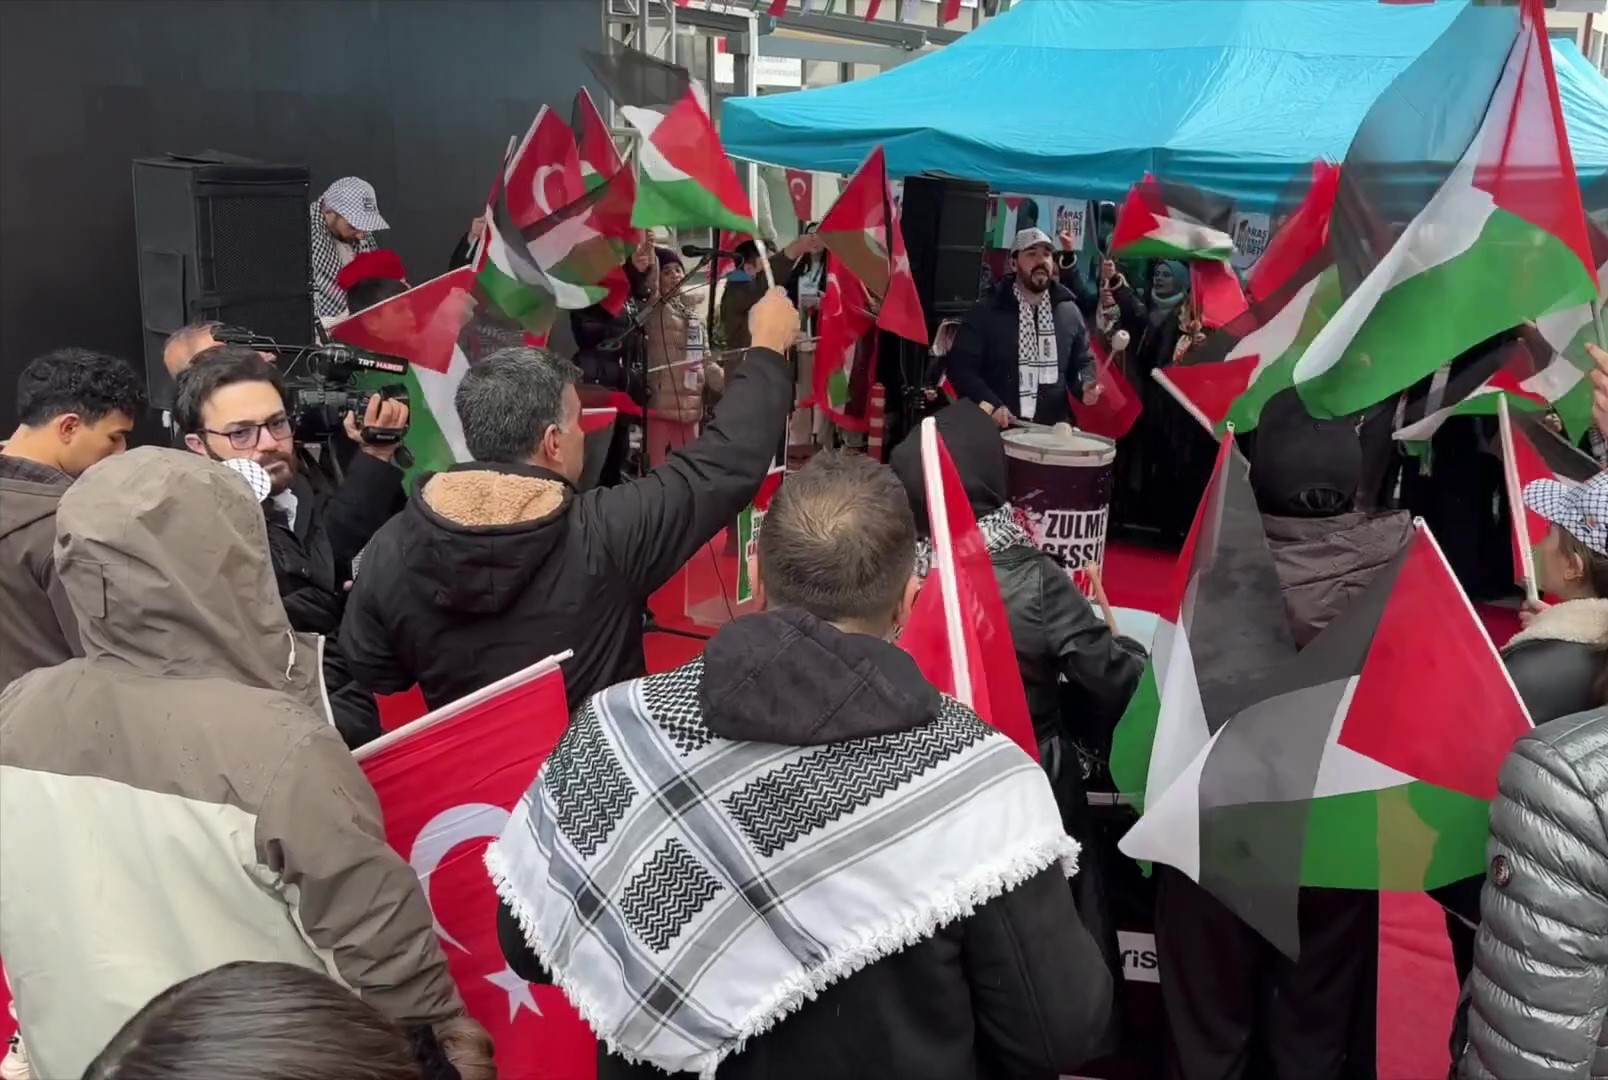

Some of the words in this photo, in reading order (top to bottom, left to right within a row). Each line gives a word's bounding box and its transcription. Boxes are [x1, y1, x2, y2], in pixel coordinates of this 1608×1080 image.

[358, 357, 375, 367] TRT
[375, 361, 404, 372] HABER
[1042, 539, 1104, 569] ESSİ
